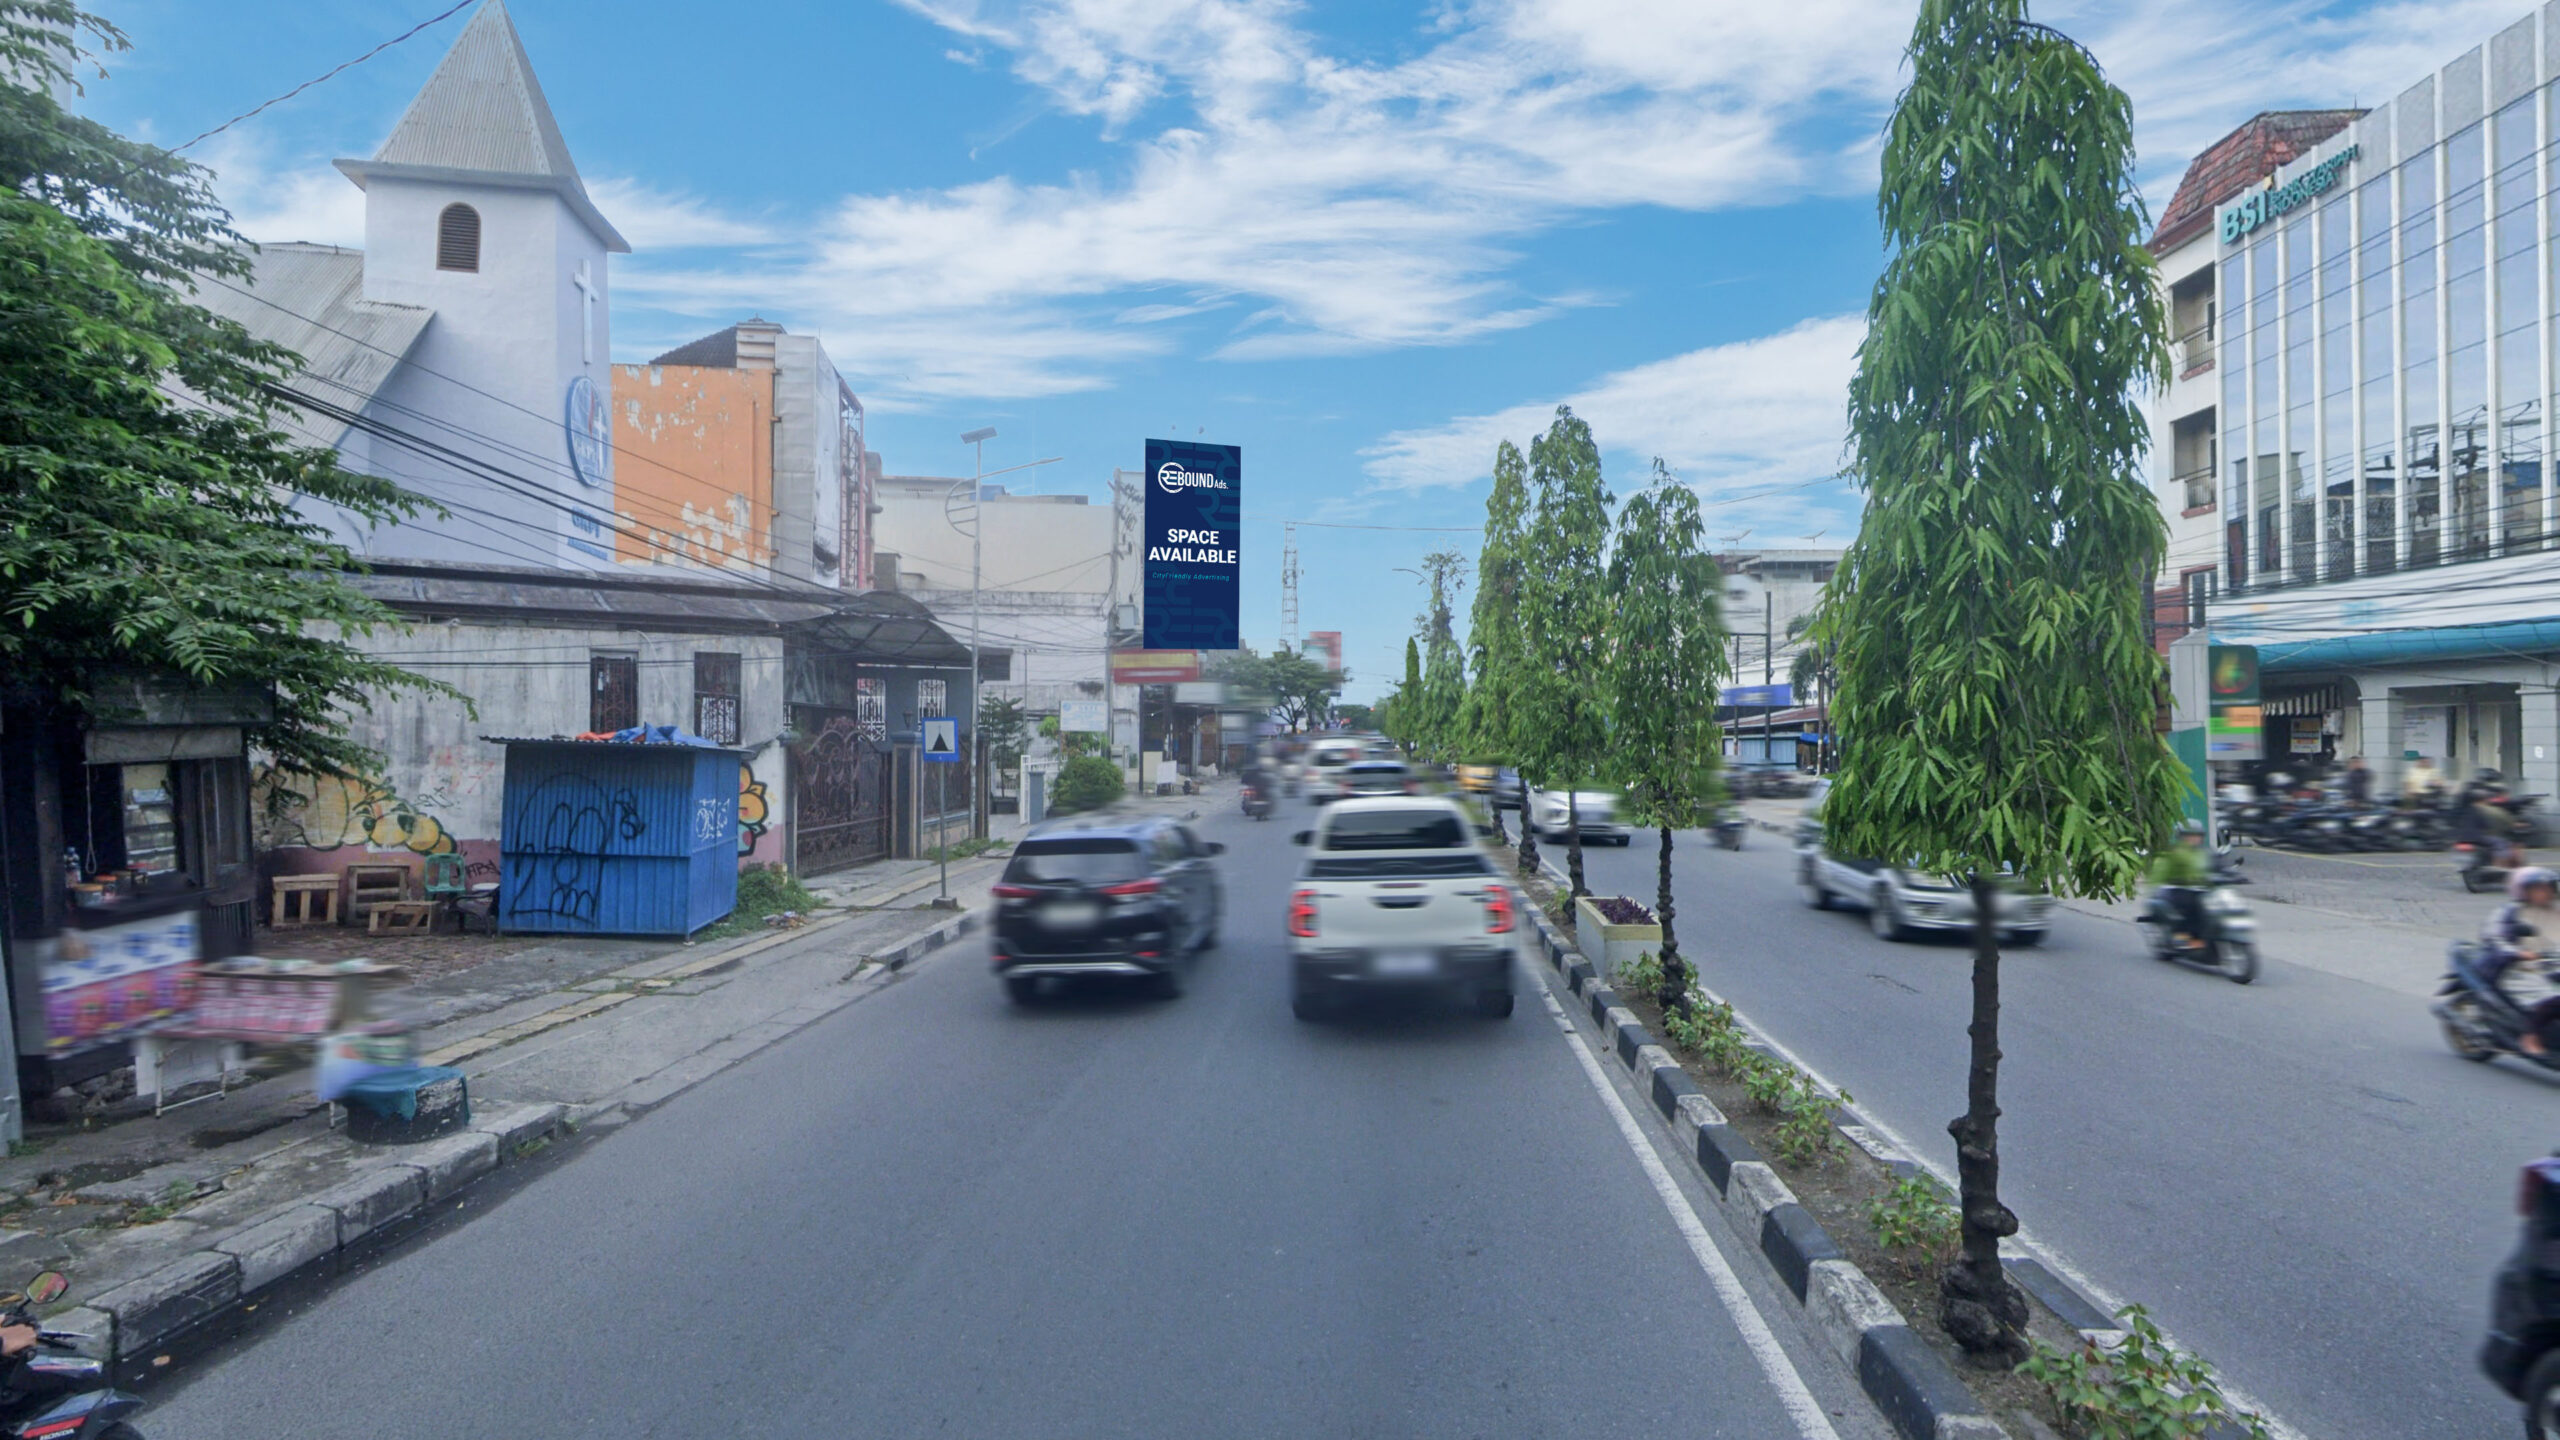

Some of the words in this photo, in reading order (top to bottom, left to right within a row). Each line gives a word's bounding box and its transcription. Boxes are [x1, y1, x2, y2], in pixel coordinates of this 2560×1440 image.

[2221, 190, 2267, 245] BSI
[1159, 465, 1214, 490] REBOUND
[1214, 480, 1229, 490] Ads.
[1167, 528, 1219, 544] SPACE
[1148, 546, 1237, 563] AVAILABLE
[1193, 573, 1230, 582] Advertising
[40, 1428, 75, 1440] HONDA
